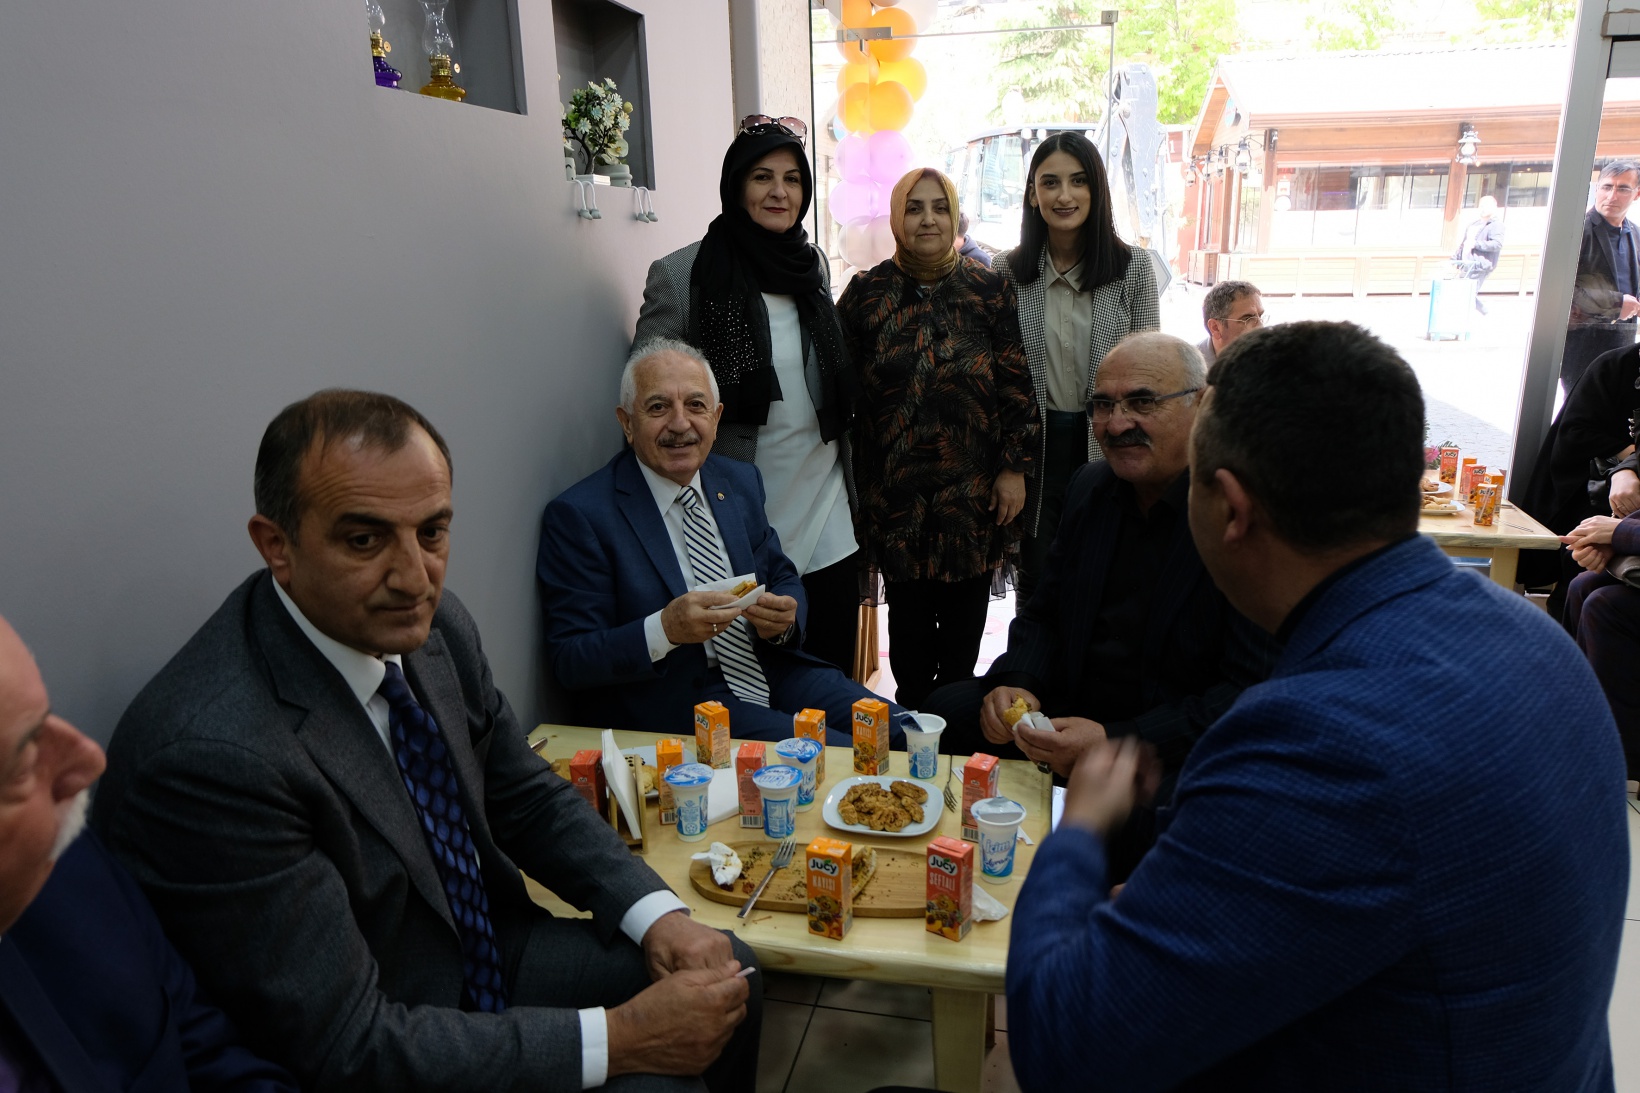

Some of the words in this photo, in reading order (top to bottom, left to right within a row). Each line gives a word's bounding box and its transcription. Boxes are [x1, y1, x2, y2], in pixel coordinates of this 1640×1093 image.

[855, 712, 873, 726] Jucy
[811, 859, 837, 874] Jucy
[931, 856, 956, 874] Jucy
